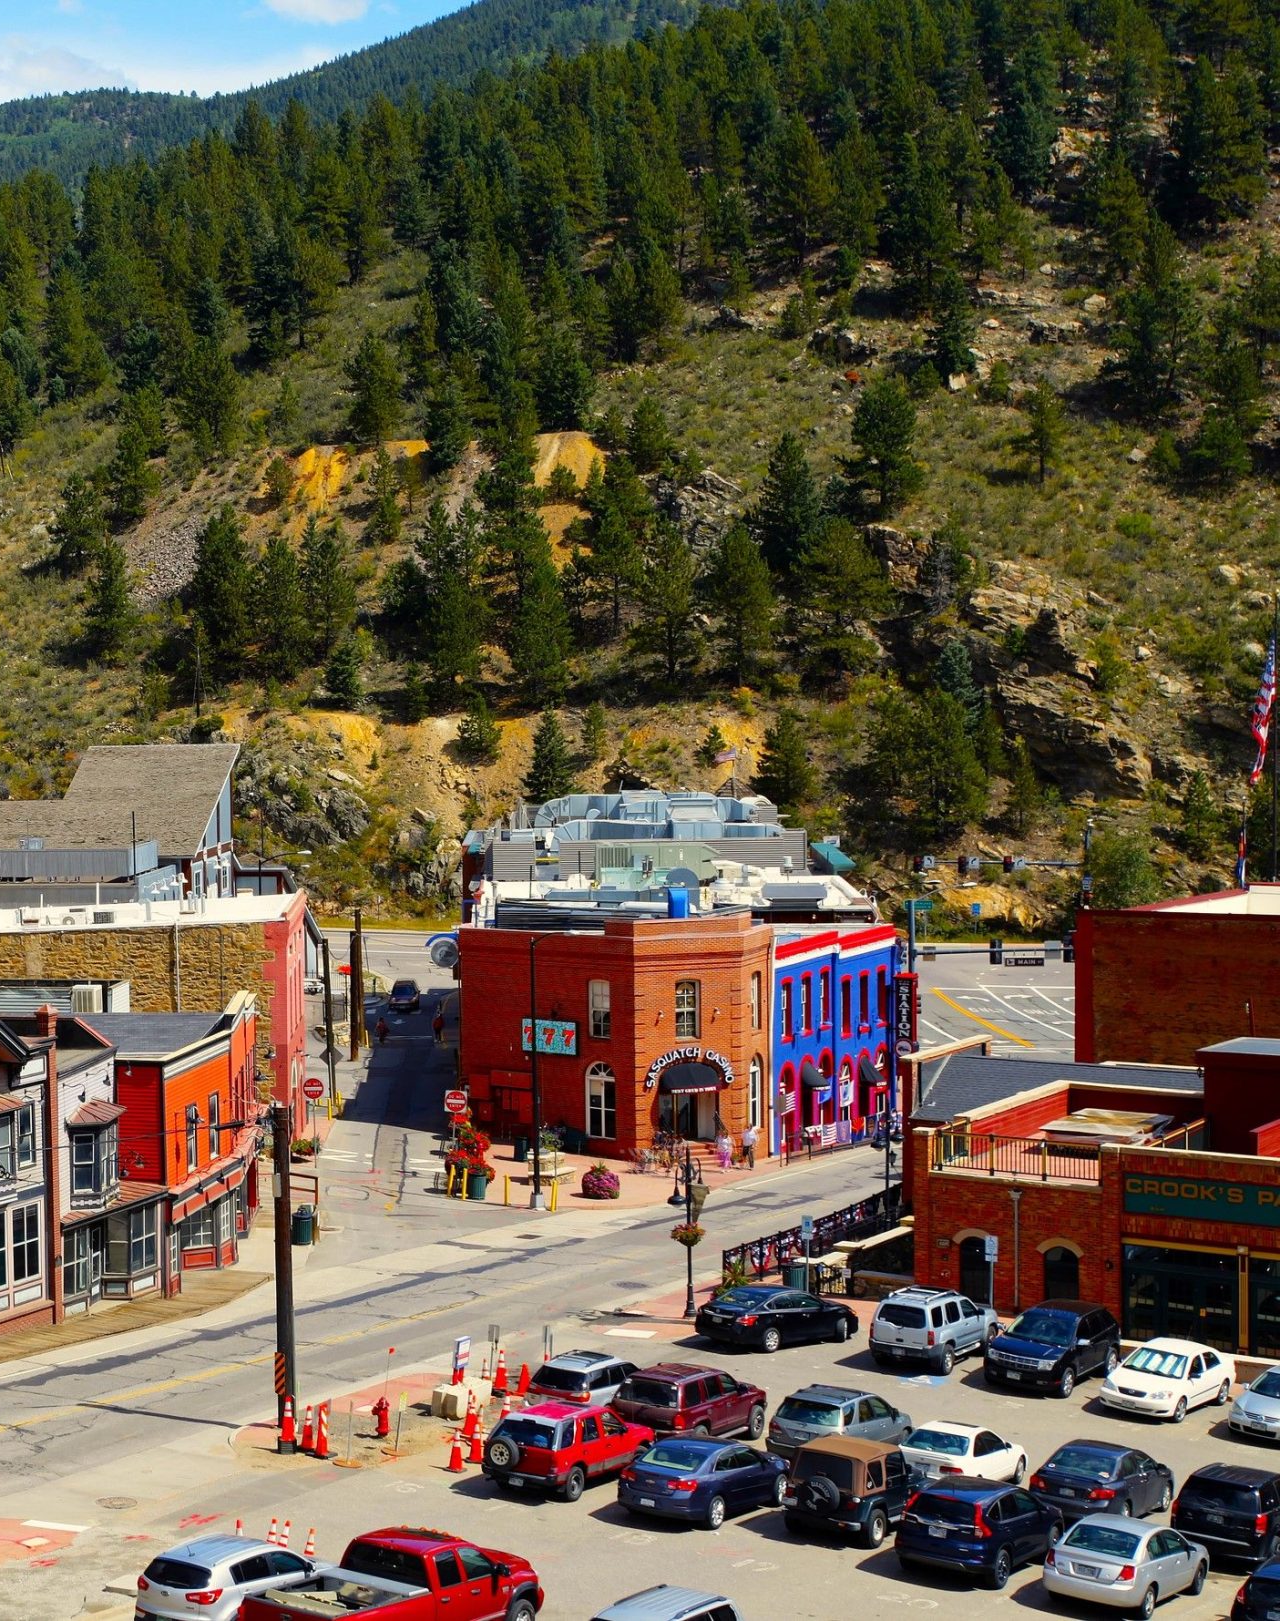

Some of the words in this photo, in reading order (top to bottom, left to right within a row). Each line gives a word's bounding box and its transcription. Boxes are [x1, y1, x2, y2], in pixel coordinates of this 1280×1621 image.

[898, 986, 911, 1037] STATION
[646, 1048, 701, 1088] SASQUATCH
[706, 1050, 735, 1083] CASINO
[1125, 1178, 1245, 1204] CROOK'S
